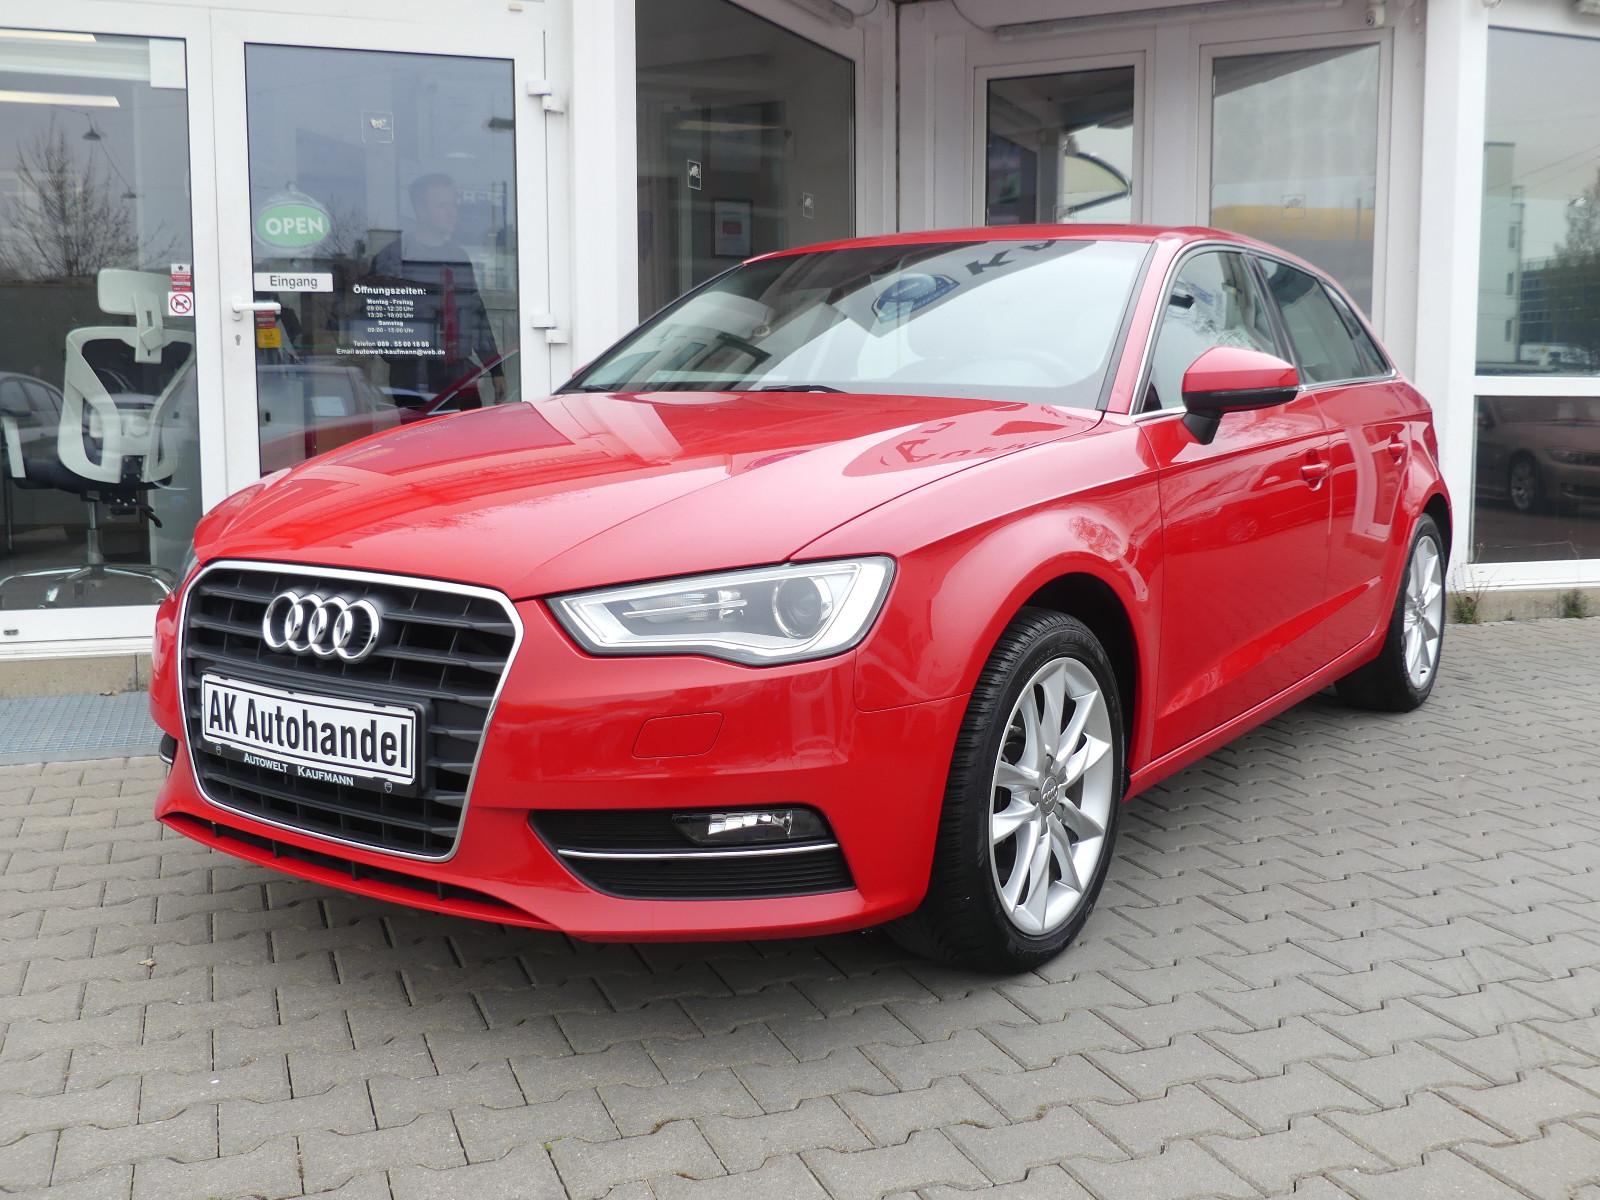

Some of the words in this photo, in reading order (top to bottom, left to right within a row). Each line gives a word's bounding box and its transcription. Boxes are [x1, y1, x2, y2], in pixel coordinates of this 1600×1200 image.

[265, 216, 324, 236] OPEN
[270, 275, 318, 289] Eingang
[353, 284, 427, 297] Öffnungszeiten:
[209, 690, 238, 735] AK
[245, 697, 408, 769] Autohandel
[243, 752, 288, 773] AUTOWELT
[297, 766, 354, 787] KAUFMANN
